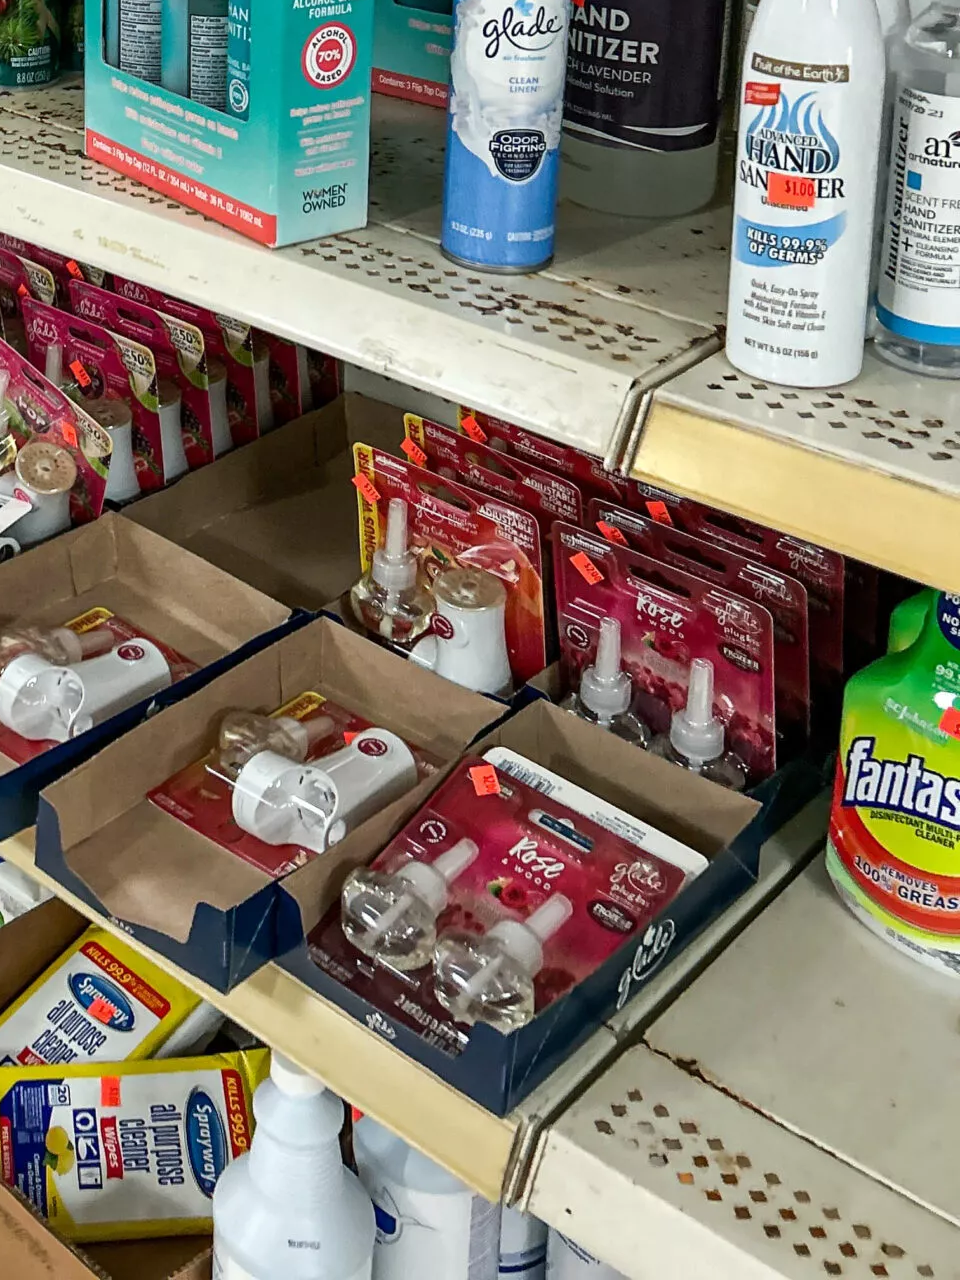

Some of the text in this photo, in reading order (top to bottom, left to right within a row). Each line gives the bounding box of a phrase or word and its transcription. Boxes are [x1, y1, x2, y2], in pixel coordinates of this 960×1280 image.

[309, 3, 352, 19] FORMULA
[312, 28, 348, 49] ALCOHOL
[483, 6, 563, 58] glade
[318, 48, 341, 63] 70%
[569, 31, 660, 64] NITIZER
[314, 69, 343, 83] BASED
[581, 64, 652, 84] LAVENDER
[755, 57, 833, 80] Fruit of the Earth
[594, 83, 634, 98] Solution
[490, 142, 545, 153] FIGHTING
[501, 135, 539, 144] ODOR
[759, 129, 818, 147] ADVANCED
[748, 135, 832, 174] HAND
[740, 160, 845, 198] SANER
[894, 116, 909, 221] sanitizer
[785, 181, 814, 197] $1.00
[904, 191, 937, 208] SCENT
[302, 196, 346, 213] OWNED
[904, 203, 937, 220] HAND
[747, 227, 827, 252] KILLS 99.9%
[750, 242, 765, 255] OF
[870, 809, 925, 832] DISINFECTANT
[915, 828, 955, 849] CLEANER
[509, 836, 565, 879] Rose
[881, 862, 937, 894] REMOVES
[897, 883, 960, 910] GREAS
[86, 947, 108, 965] KILLS
[47, 999, 107, 1055] all purpose
[32, 1029, 78, 1064] cleaner
[58, 1086, 67, 1103] 20
[227, 1077, 240, 1111] KILLS
[104, 1127, 118, 1168] Wipes
[119, 1118, 150, 1173] cleaner
[149, 1104, 184, 1186] all purpose
[196, 1104, 216, 1183] Sprayway
